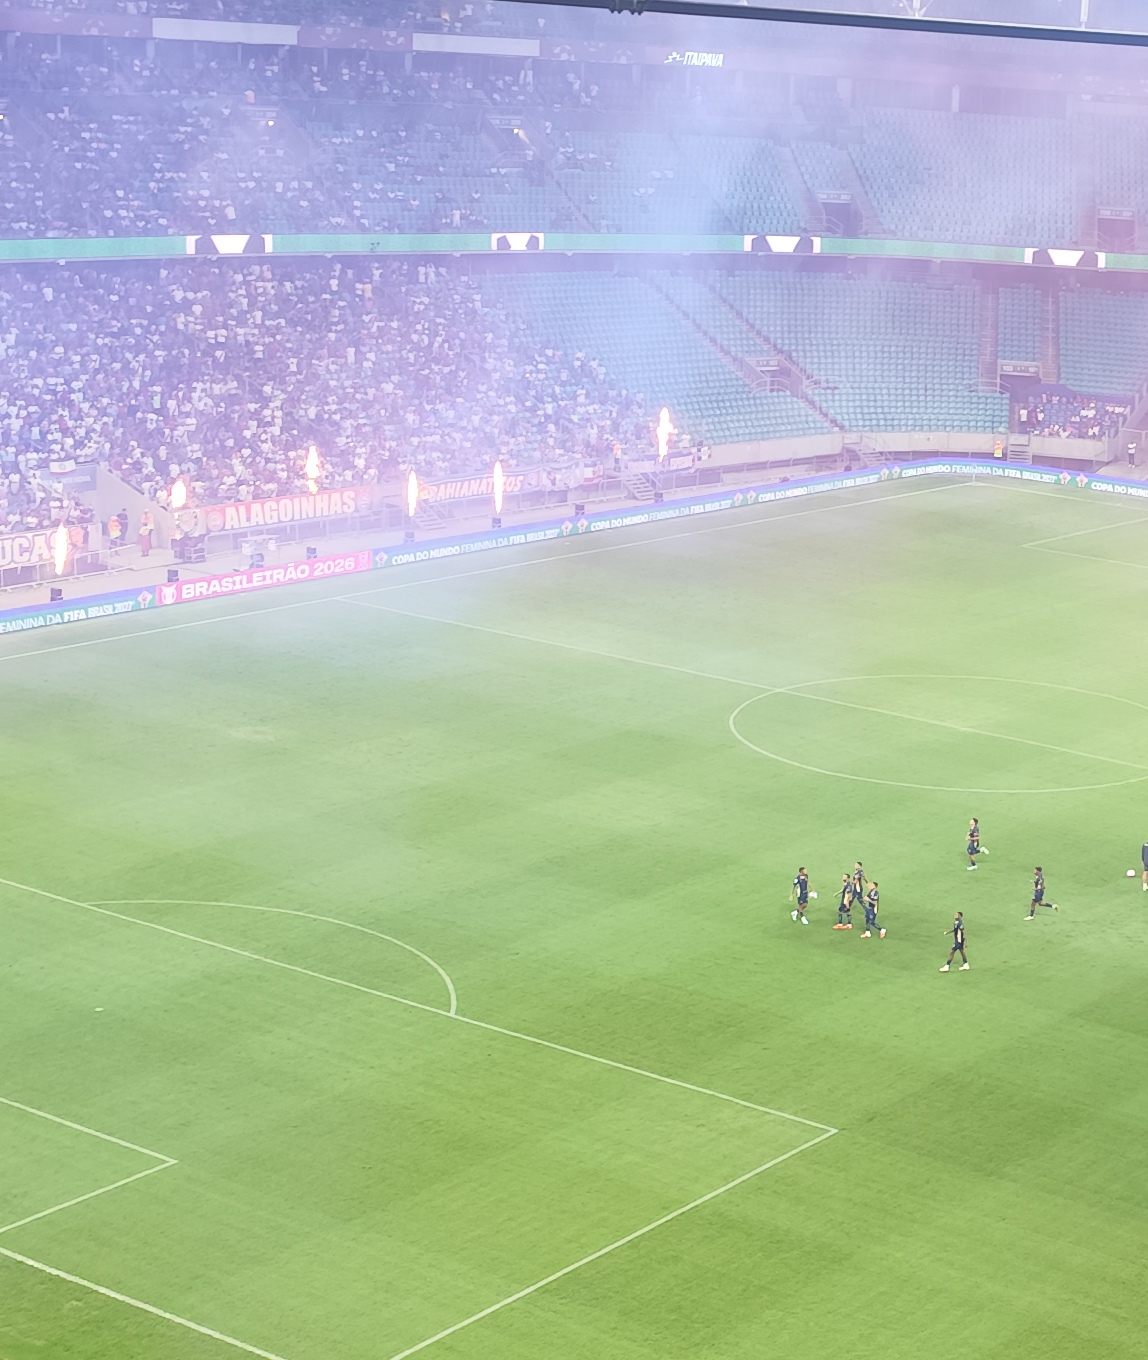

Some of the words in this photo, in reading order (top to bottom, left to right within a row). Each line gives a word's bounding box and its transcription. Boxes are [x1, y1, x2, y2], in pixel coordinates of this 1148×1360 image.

[1091, 482, 1114, 493] COPA
[1115, 485, 1127, 494] DO
[224, 490, 356, 530] ALAGOINHAS
[391, 550, 416, 566] COPA
[415, 547, 429, 561] DO
[429, 543, 461, 558] MUNDO
[460, 538, 498, 554] FEMININA
[497, 536, 509, 548] DA
[508, 533, 527, 545] FIFA
[181, 563, 310, 600] BRASILEIRÃO
[312, 557, 355, 576] 2026
[46, 614, 62, 625] DA
[63, 608, 88, 623] FIFA
[87, 603, 115, 618] BRASIL
